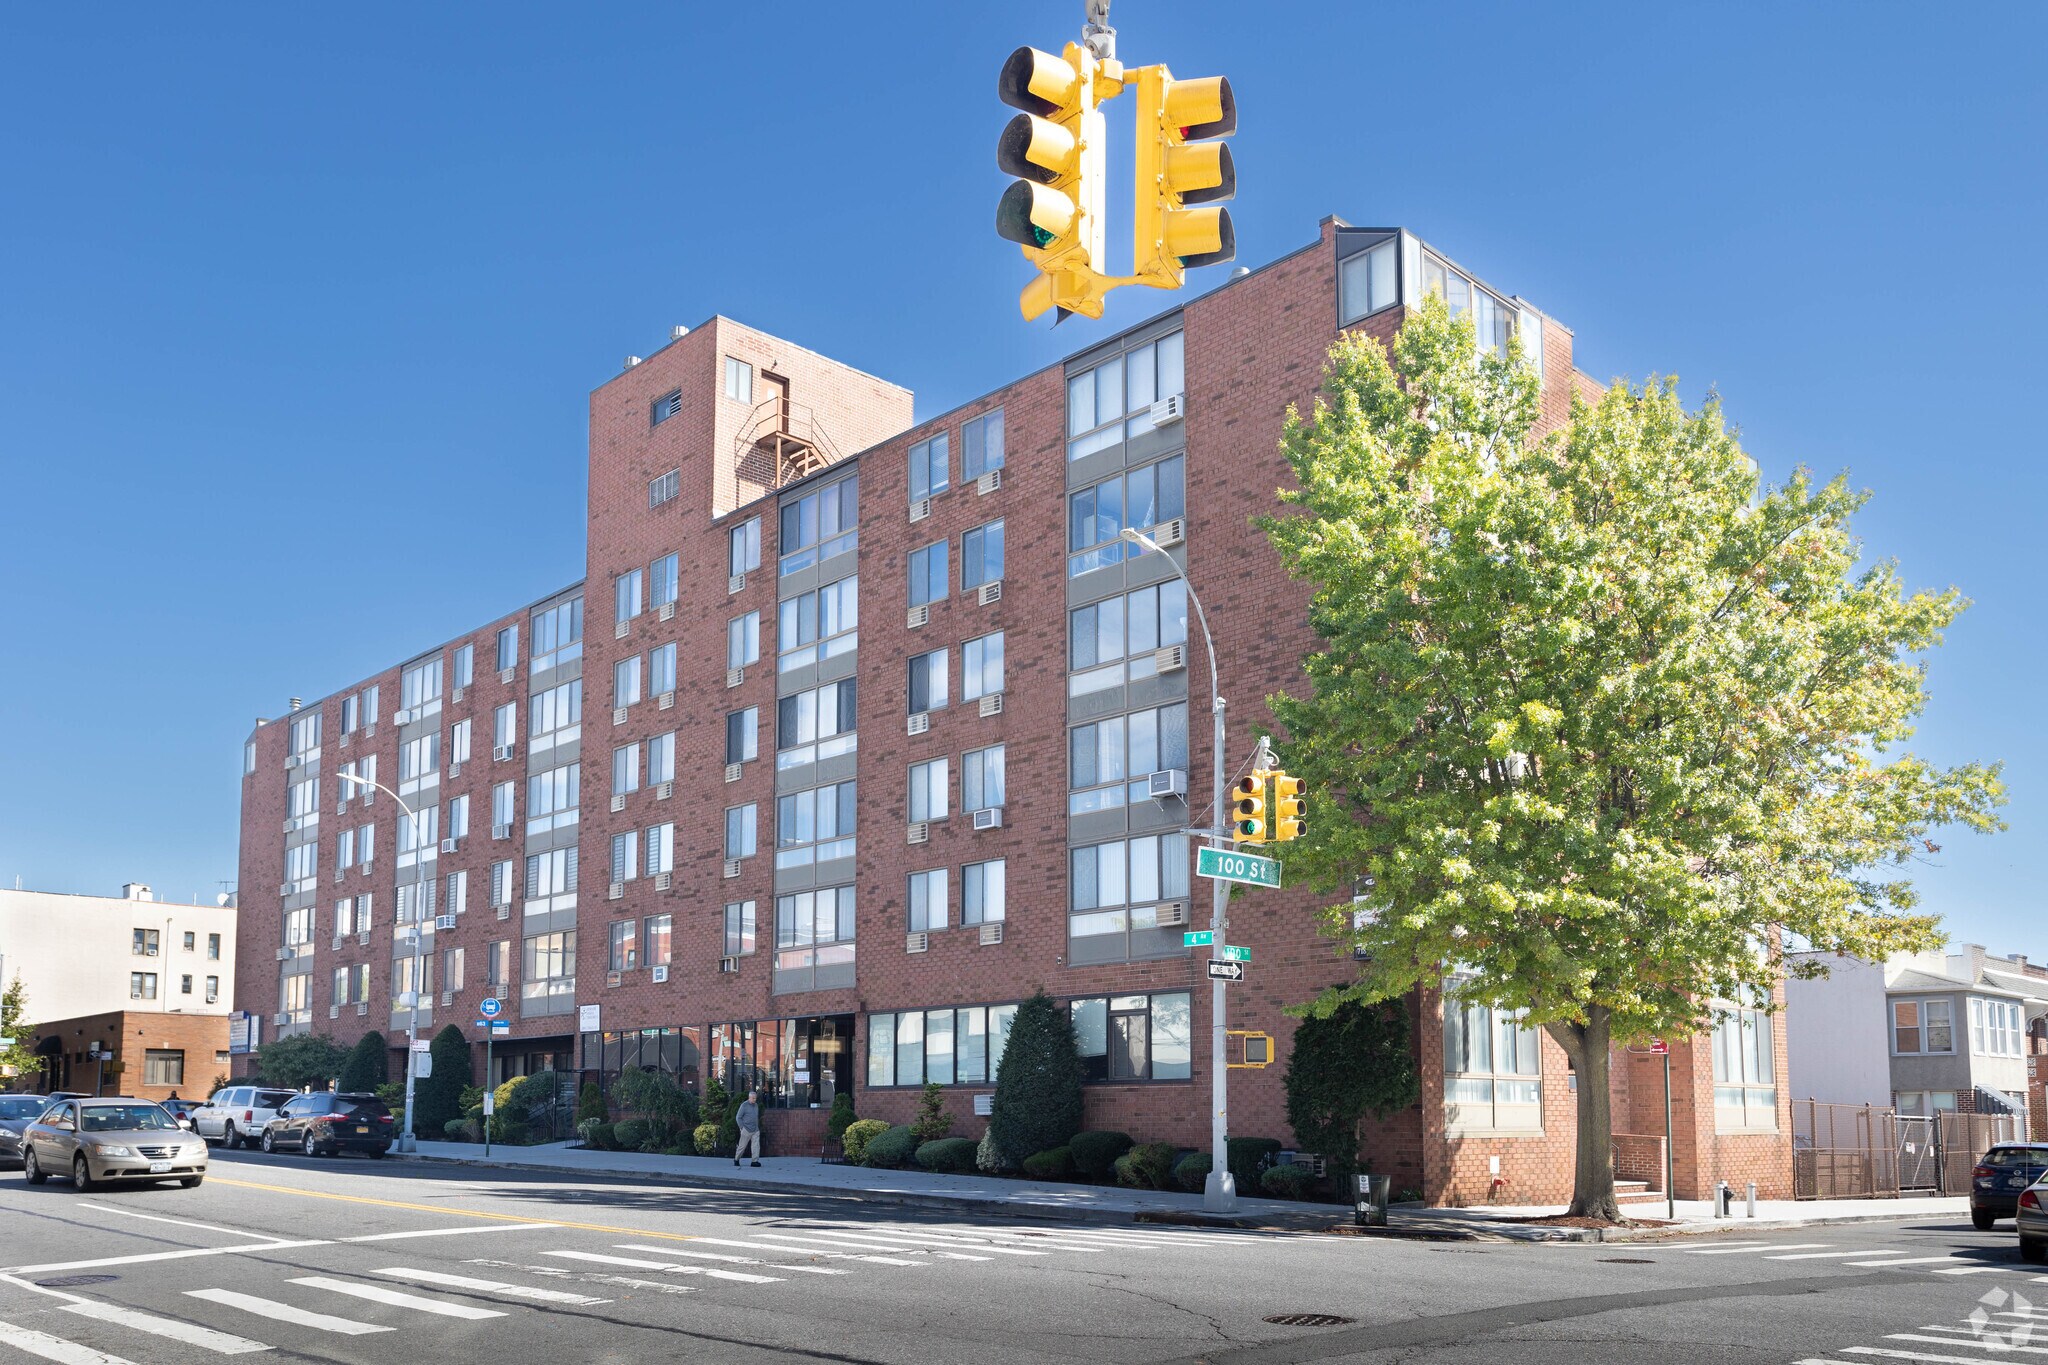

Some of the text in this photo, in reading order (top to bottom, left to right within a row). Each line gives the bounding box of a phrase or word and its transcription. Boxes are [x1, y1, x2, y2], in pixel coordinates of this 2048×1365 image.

[1218, 856, 1266, 880] 100 St
[1191, 933, 1198, 945] 4
[1226, 947, 1241, 959] 100
[1212, 965, 1238, 975] ONE WAY
